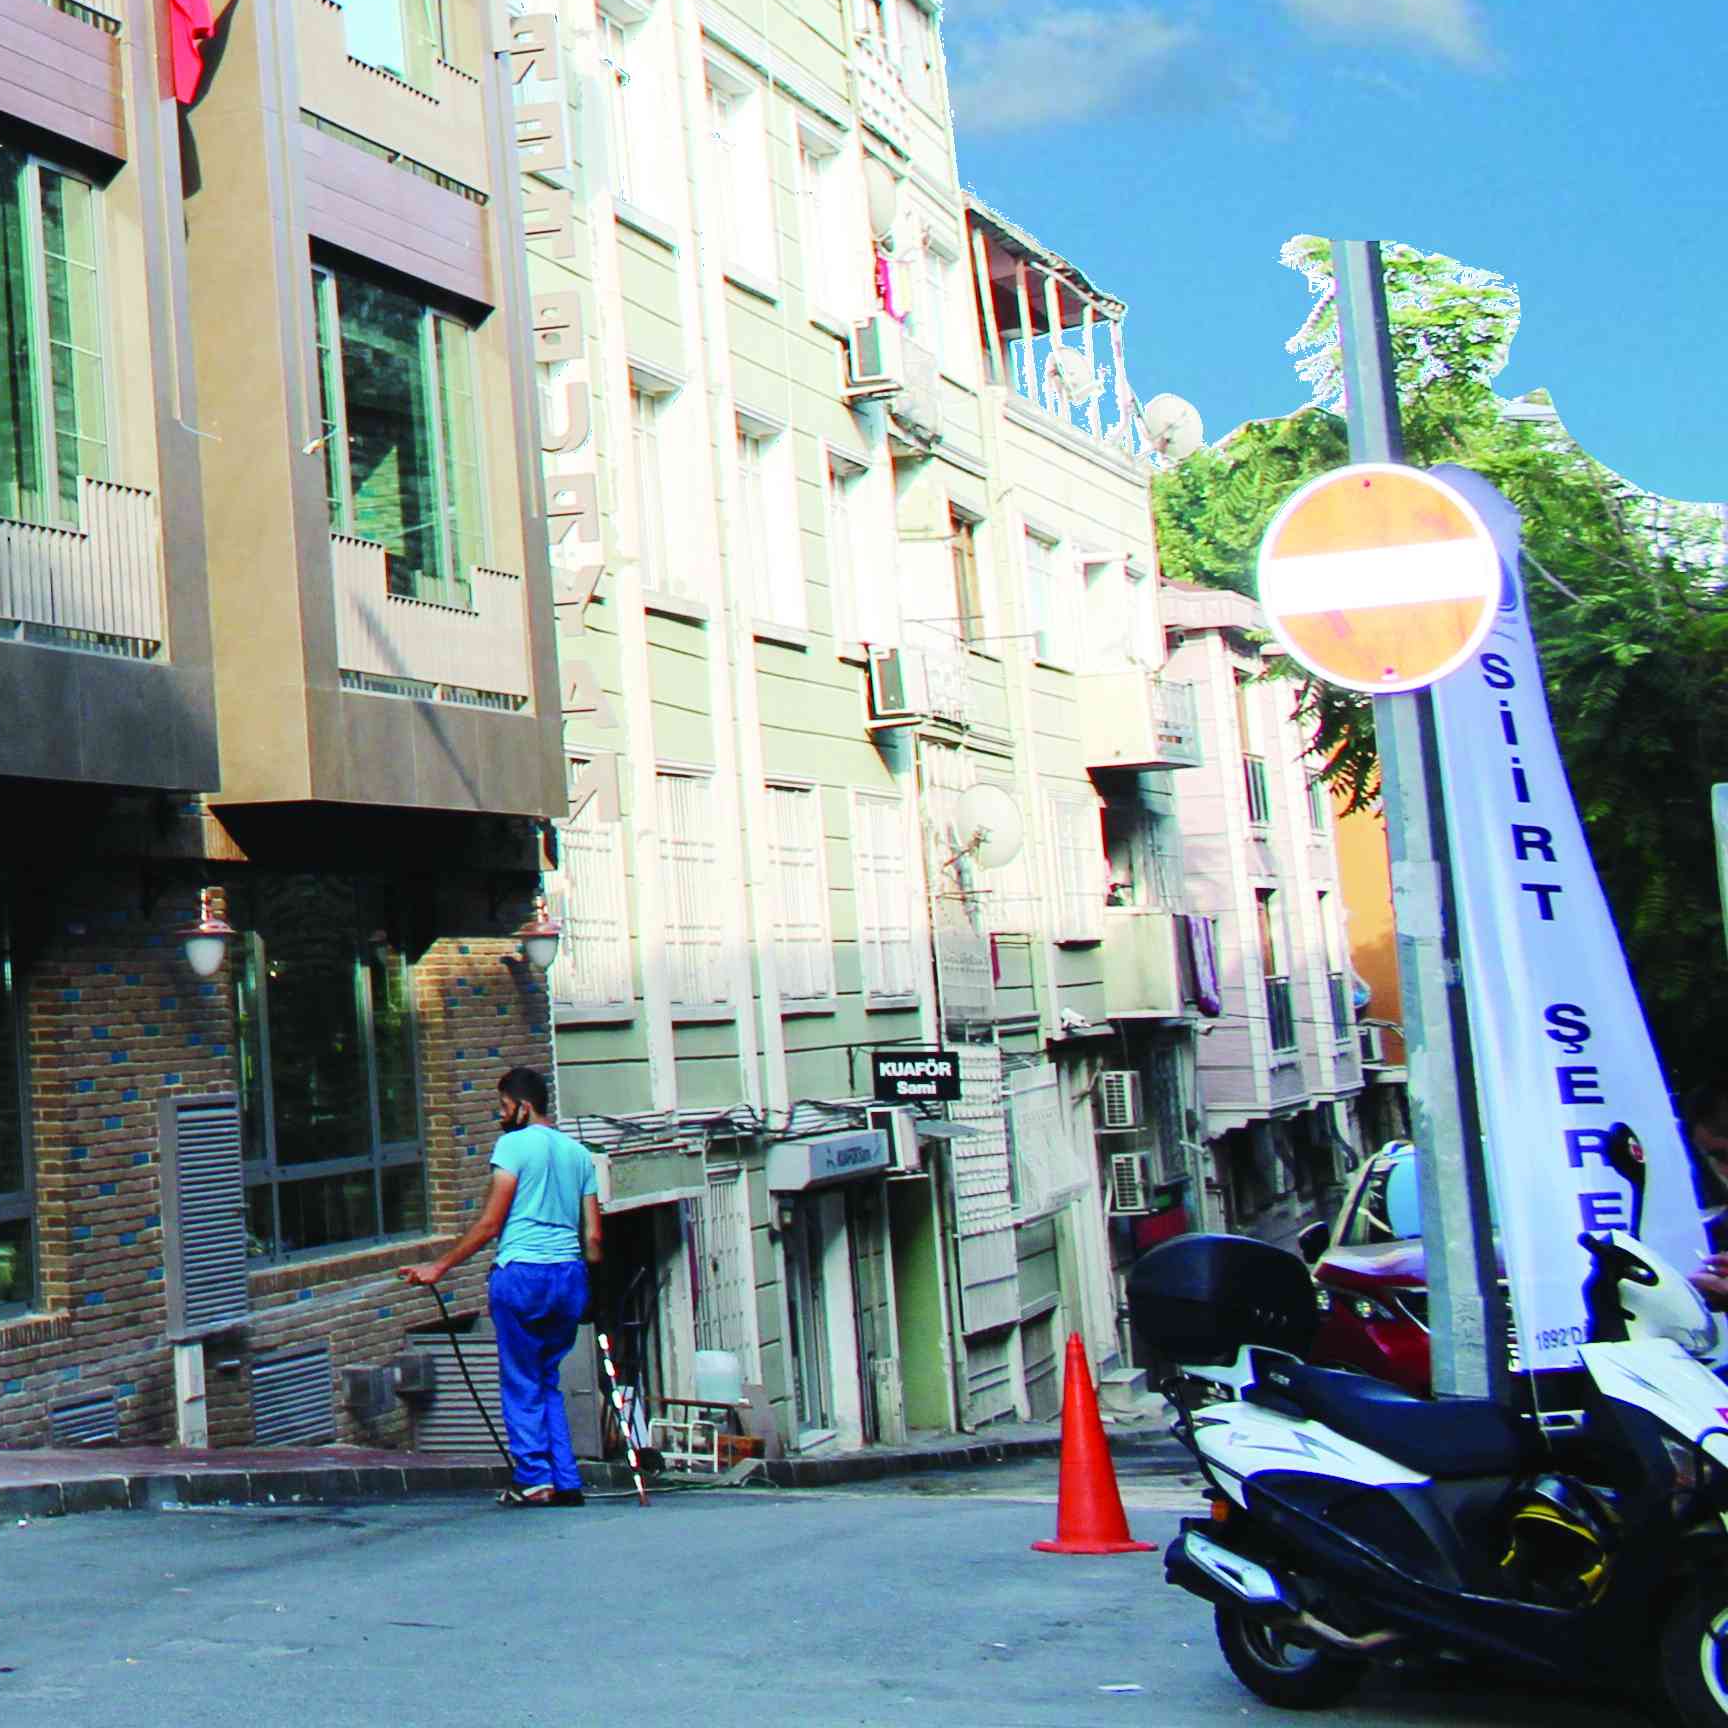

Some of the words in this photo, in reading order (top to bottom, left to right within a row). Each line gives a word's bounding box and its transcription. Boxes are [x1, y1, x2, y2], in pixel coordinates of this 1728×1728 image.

[879, 1058, 951, 1077] KUAFÖR
[897, 1081, 936, 1095] Sami
[1544, 1003, 1628, 1231] ŞERE
[1536, 1327, 1583, 1351] 1892'D
